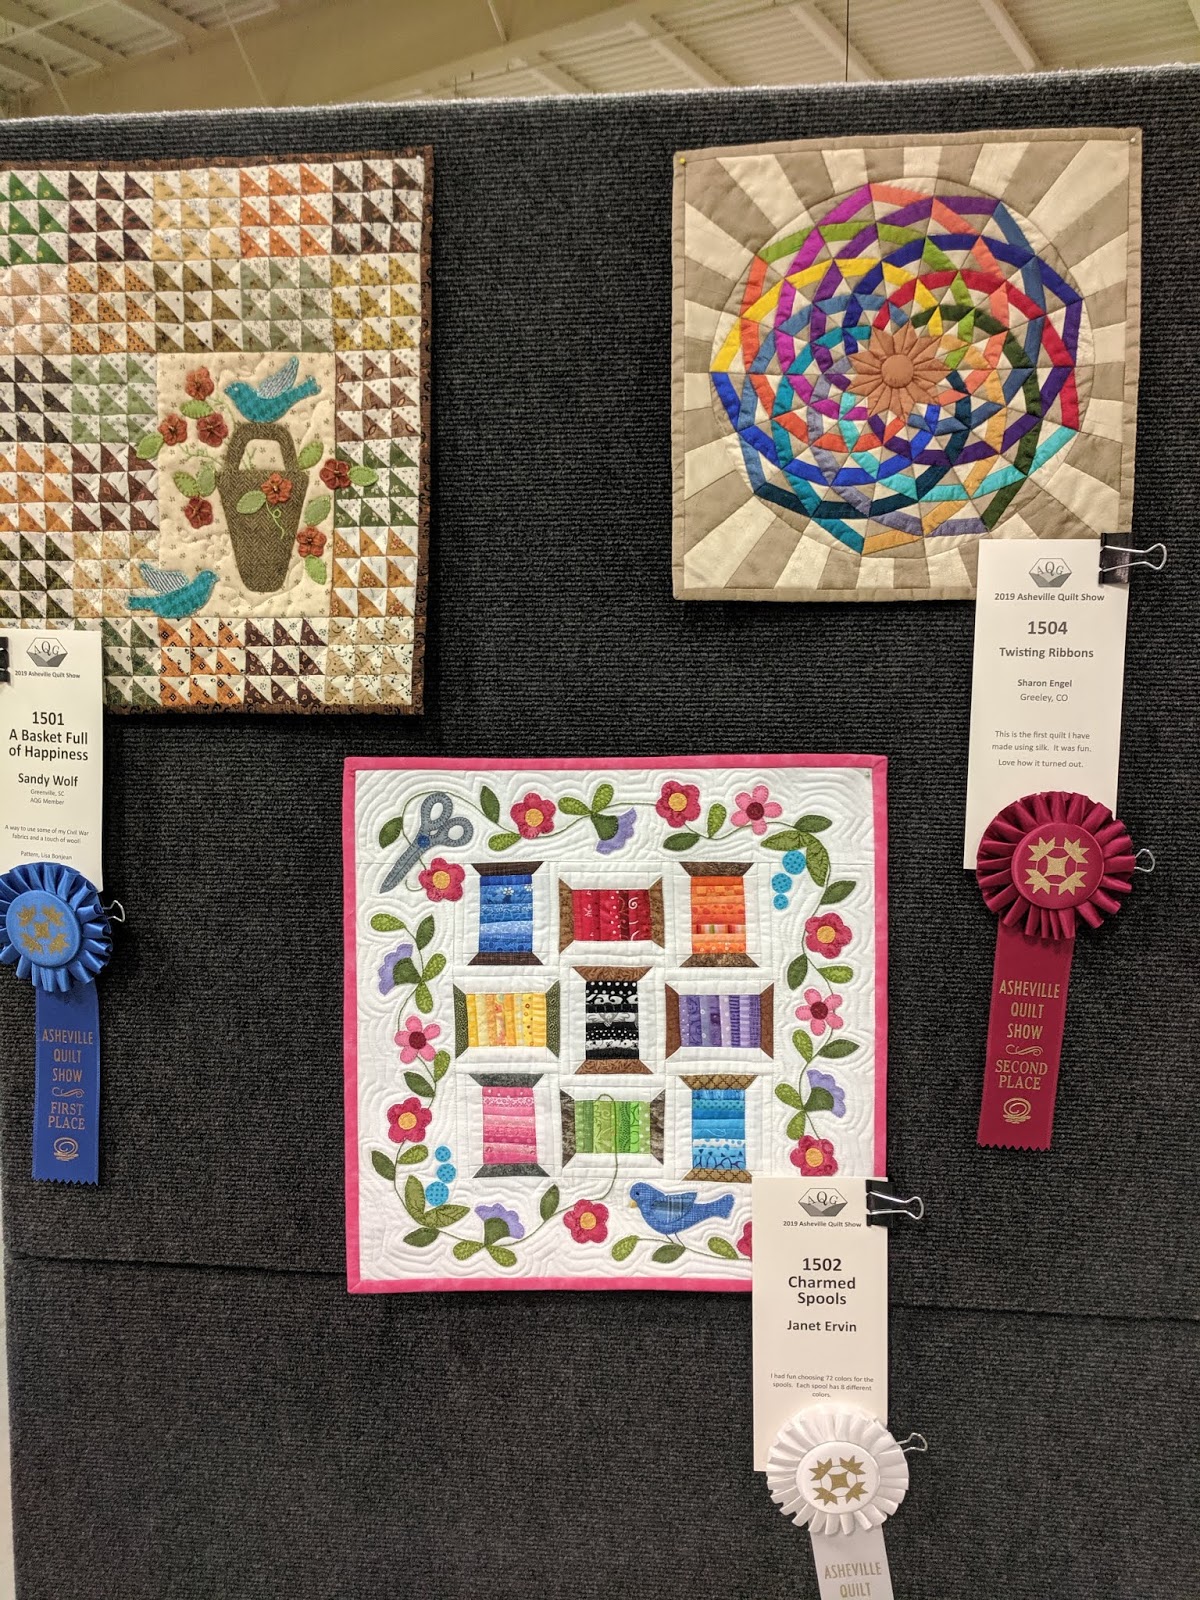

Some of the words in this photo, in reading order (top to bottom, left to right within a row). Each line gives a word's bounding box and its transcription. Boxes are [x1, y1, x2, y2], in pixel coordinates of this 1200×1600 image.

[1037, 562, 1064, 576] AQG
[1017, 593, 1055, 601] Asheville
[1028, 621, 1068, 635] 1504
[1000, 648, 1045, 659] Twisting
[1049, 648, 1094, 658] Ribbons
[1018, 679, 1047, 687] Sharon
[1050, 680, 1072, 688] Engel
[1020, 694, 1054, 703] Greeley,
[1056, 694, 1068, 702] CO
[33, 712, 64, 726] 1501
[9, 729, 18, 741] A
[22, 730, 62, 743] Basket
[67, 732, 88, 744] Full
[1050, 732, 1066, 740] quilt
[9, 745, 22, 757] of
[25, 746, 88, 761] Happiness
[1015, 744, 1034, 752] using
[18, 773, 50, 787] Sandy
[53, 776, 78, 787] Wolf
[999, 979, 1060, 999] ASHEVILLE
[1011, 1002, 1044, 1018] QUILT
[42, 1029, 93, 1045] ASHEVILLE
[1007, 1023, 1043, 1040] SHOW
[54, 1049, 81, 1063] QUILT
[995, 1059, 1048, 1076] SECOND
[52, 1068, 82, 1083] SHOW
[999, 1075, 1041, 1090] PLACE
[51, 1102, 84, 1116] FIRST
[48, 1116, 85, 1130] PLACE
[808, 1191, 838, 1206] AQG
[802, 1258, 842, 1271] 1502
[788, 1276, 856, 1289] Charmed
[798, 1292, 847, 1306] Spools
[788, 1320, 821, 1331] Janet
[825, 1322, 857, 1332] Ervin
[825, 1562, 882, 1579] ASHEVILLE
[840, 1583, 871, 1598] QUILT
